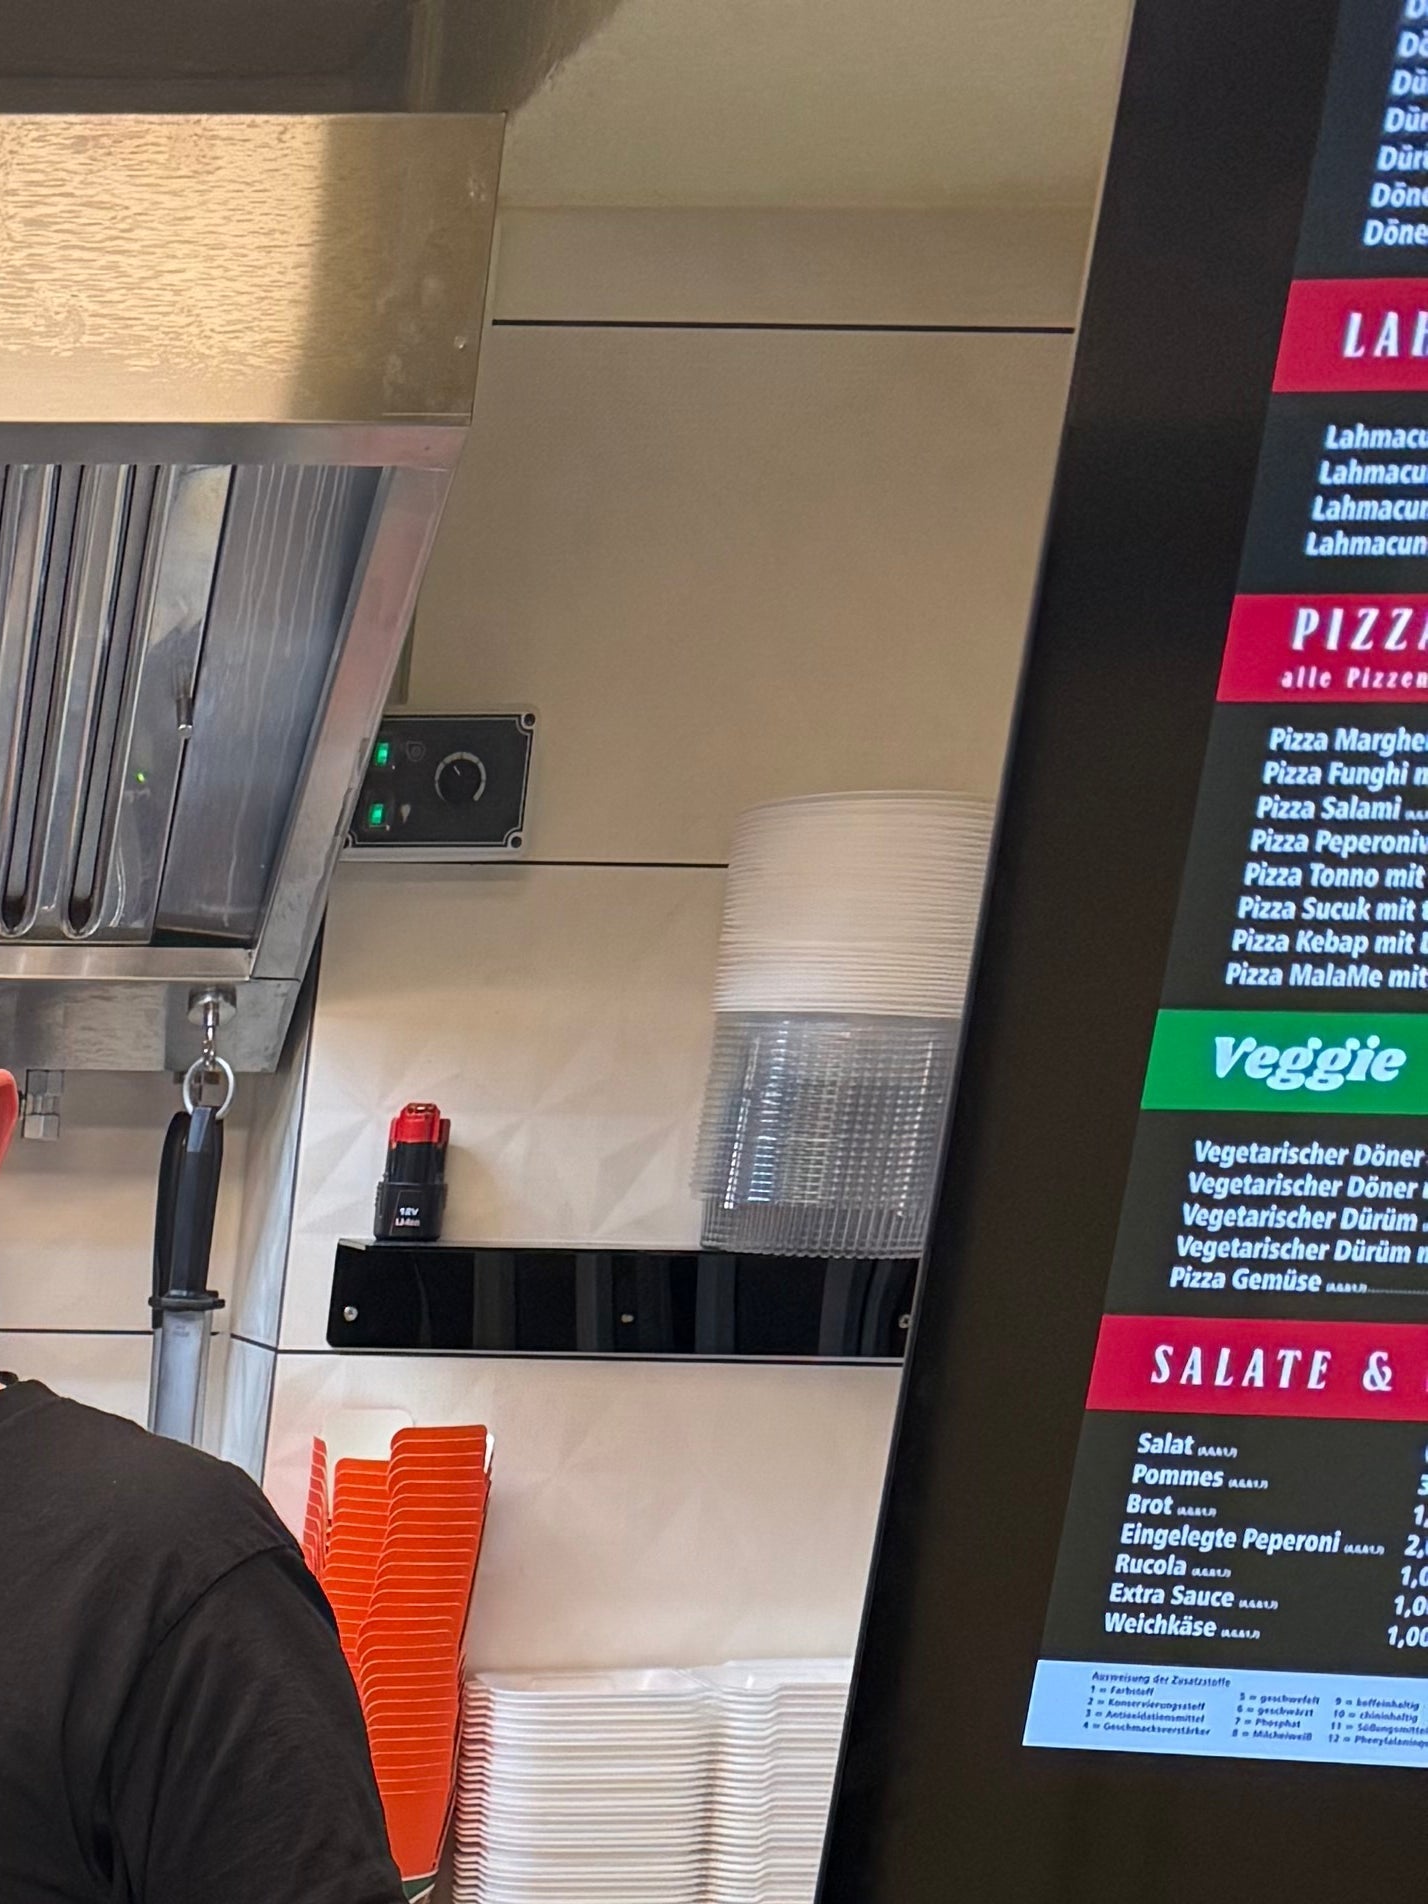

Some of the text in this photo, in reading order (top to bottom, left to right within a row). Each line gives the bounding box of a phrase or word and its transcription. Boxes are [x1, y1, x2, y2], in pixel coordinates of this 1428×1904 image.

[1281, 665, 1332, 689] alle
[1269, 726, 1329, 752] Pizza
[1262, 760, 1322, 785] Pizza
[1328, 760, 1410, 792] Funghi
[1256, 794, 1402, 820] Pizza Salami
[1250, 828, 1309, 852] Pizza
[1244, 861, 1426, 889] Pizza Tonno mit
[1237, 895, 1296, 919] Pizza
[1301, 896, 1371, 920] Sucuk
[1375, 897, 1416, 921] mit
[1231, 928, 1289, 952] Pizza
[1295, 928, 1369, 959] Kebap
[1374, 930, 1415, 954] mit
[1225, 961, 1283, 986] Pizza
[1289, 962, 1383, 988] MalaMe
[1215, 1035, 1407, 1091] Veggie
[1195, 1140, 1425, 1168] Vegetarischer Döner
[1189, 1171, 1343, 1200] Vegetarischer
[1347, 1175, 1419, 1199] Döner
[1183, 1202, 1418, 1232] Vegetarischer Dürüm
[1177, 1234, 1330, 1263] Vegetarischer
[1334, 1239, 1411, 1263] Dürüm
[1169, 1266, 1226, 1289] Pizza
[1232, 1268, 1322, 1292] Gemüse
[1151, 1344, 1393, 1392] SALATE &
[1137, 1432, 1194, 1457] Salat
[1132, 1464, 1224, 1488] Pommes
[1126, 1494, 1173, 1516] Brot
[1120, 1523, 1237, 1553] Eingelegte
[1242, 1528, 1341, 1555] Peperoni
[1114, 1554, 1187, 1576] Rucola
[1109, 1583, 1164, 1605] Extra
[1170, 1585, 1235, 1608] Sauce
[1104, 1612, 1217, 1637] Weichkäse
